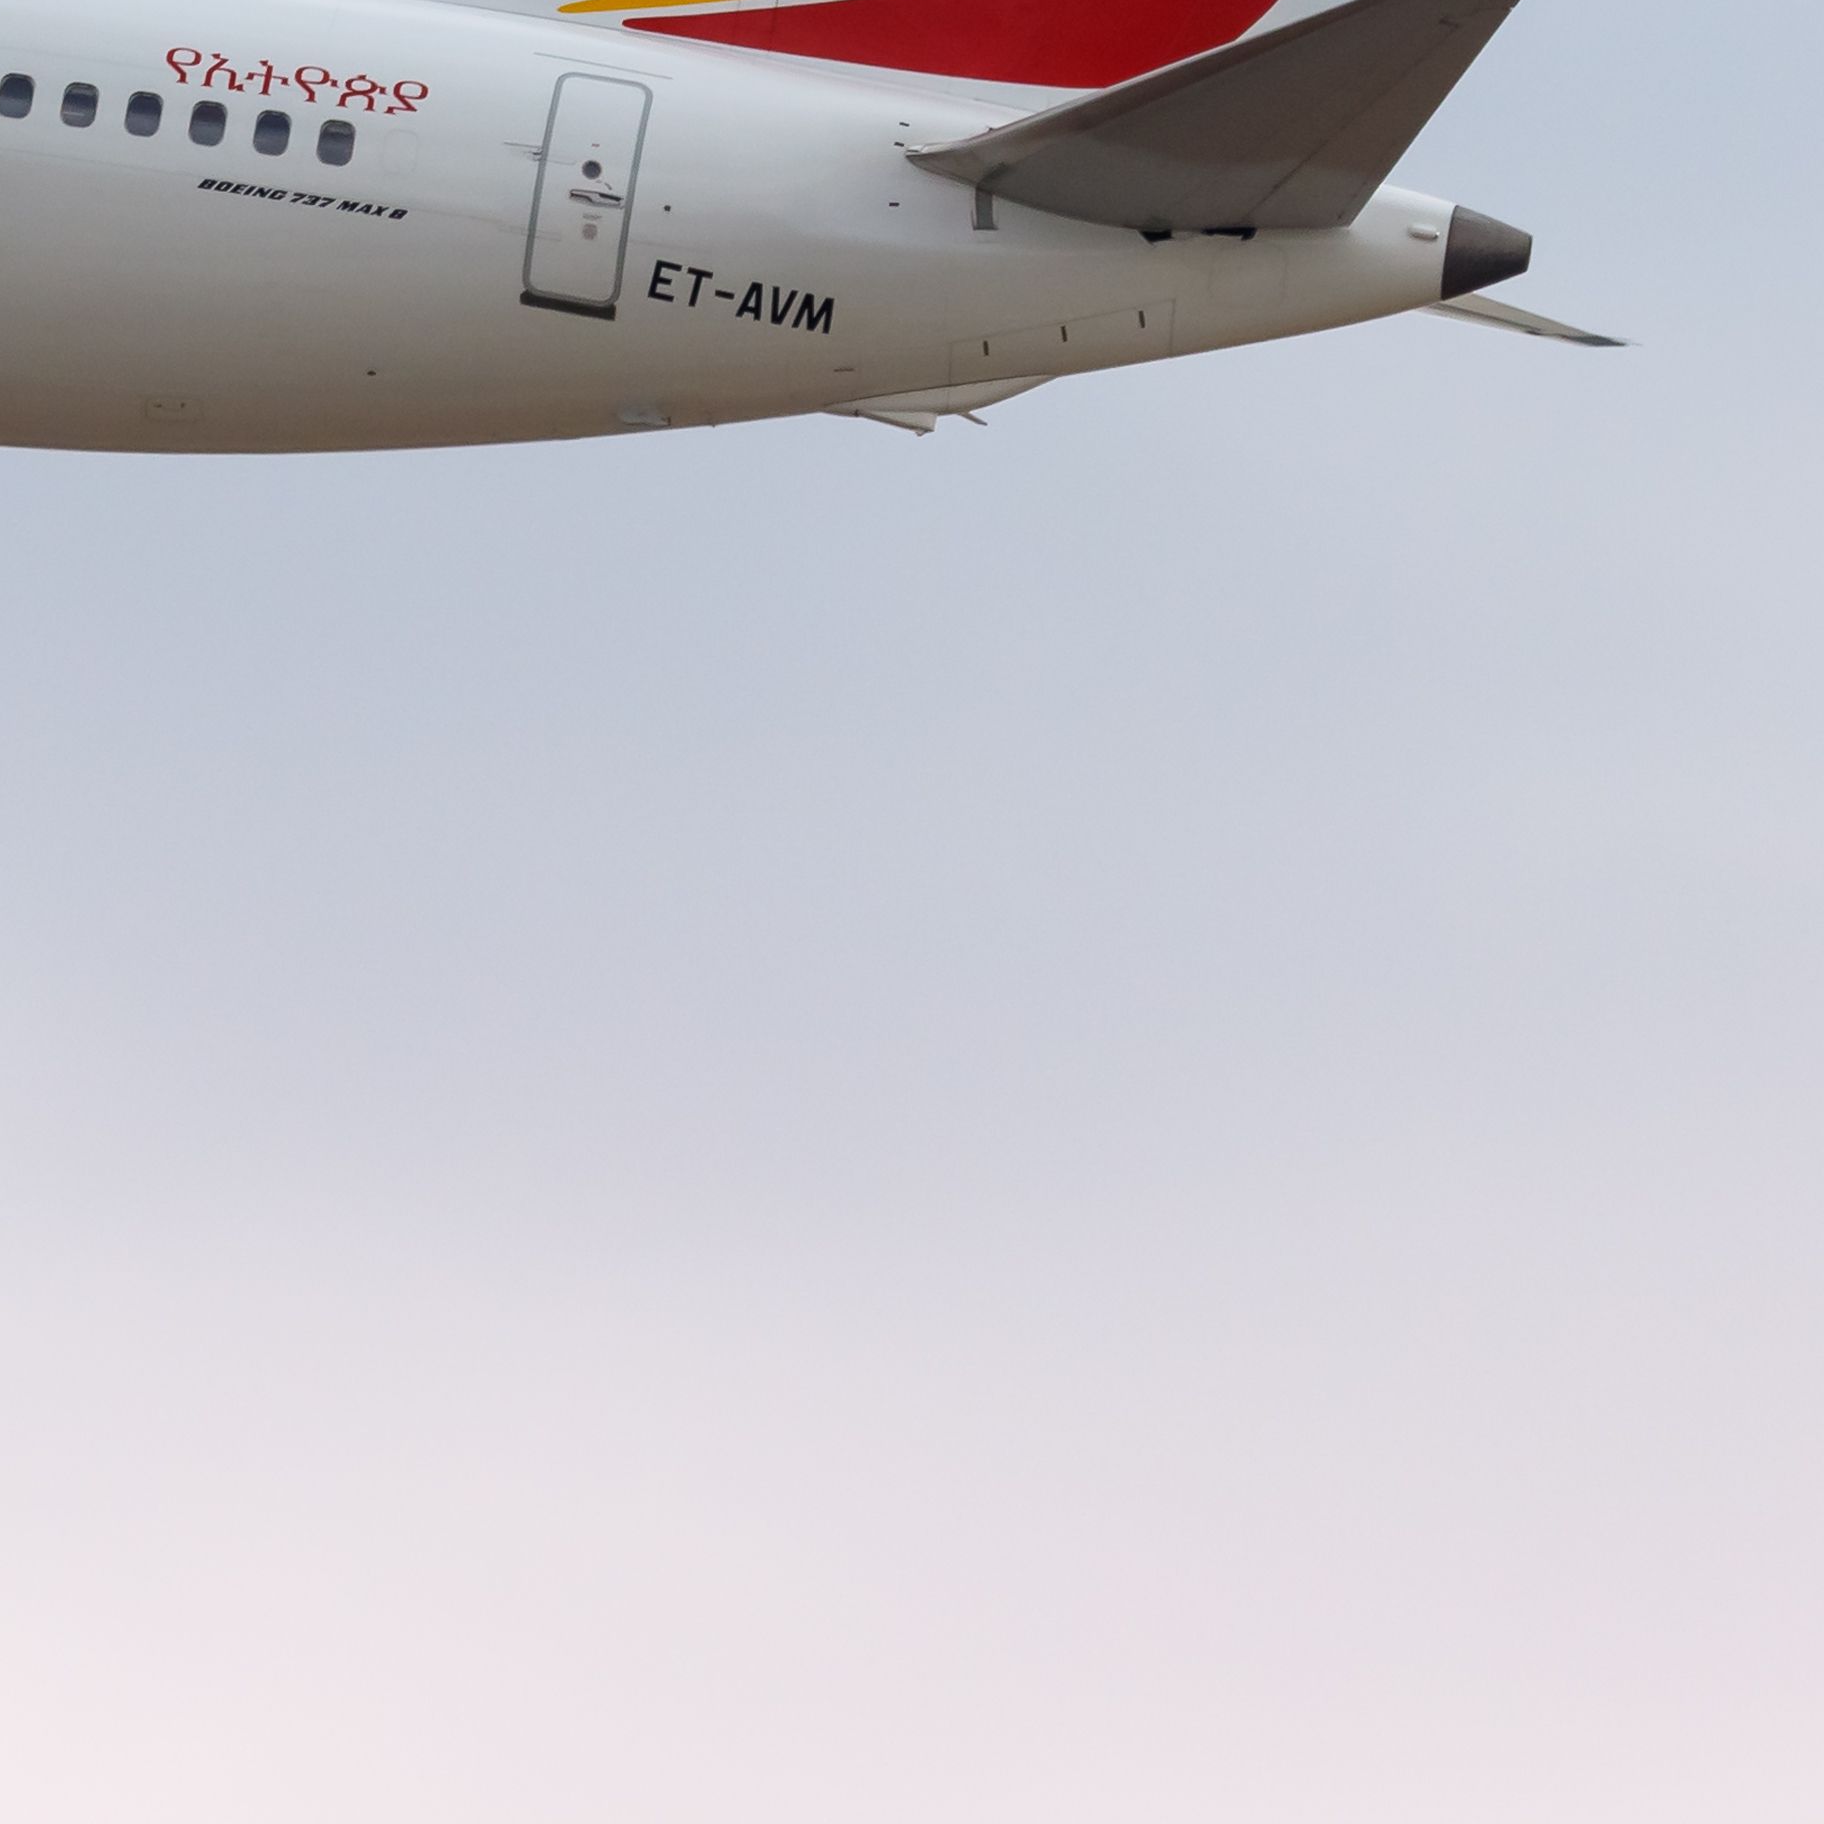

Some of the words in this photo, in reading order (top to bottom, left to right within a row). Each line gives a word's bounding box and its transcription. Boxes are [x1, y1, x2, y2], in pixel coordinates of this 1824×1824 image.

[165, 47, 429, 114] የኢትዮጵያ
[197, 178, 288, 201] BOEING
[290, 192, 336, 208] 737
[336, 199, 389, 217] MAX
[388, 208, 409, 220] 8
[647, 259, 835, 335] ET-AVM
